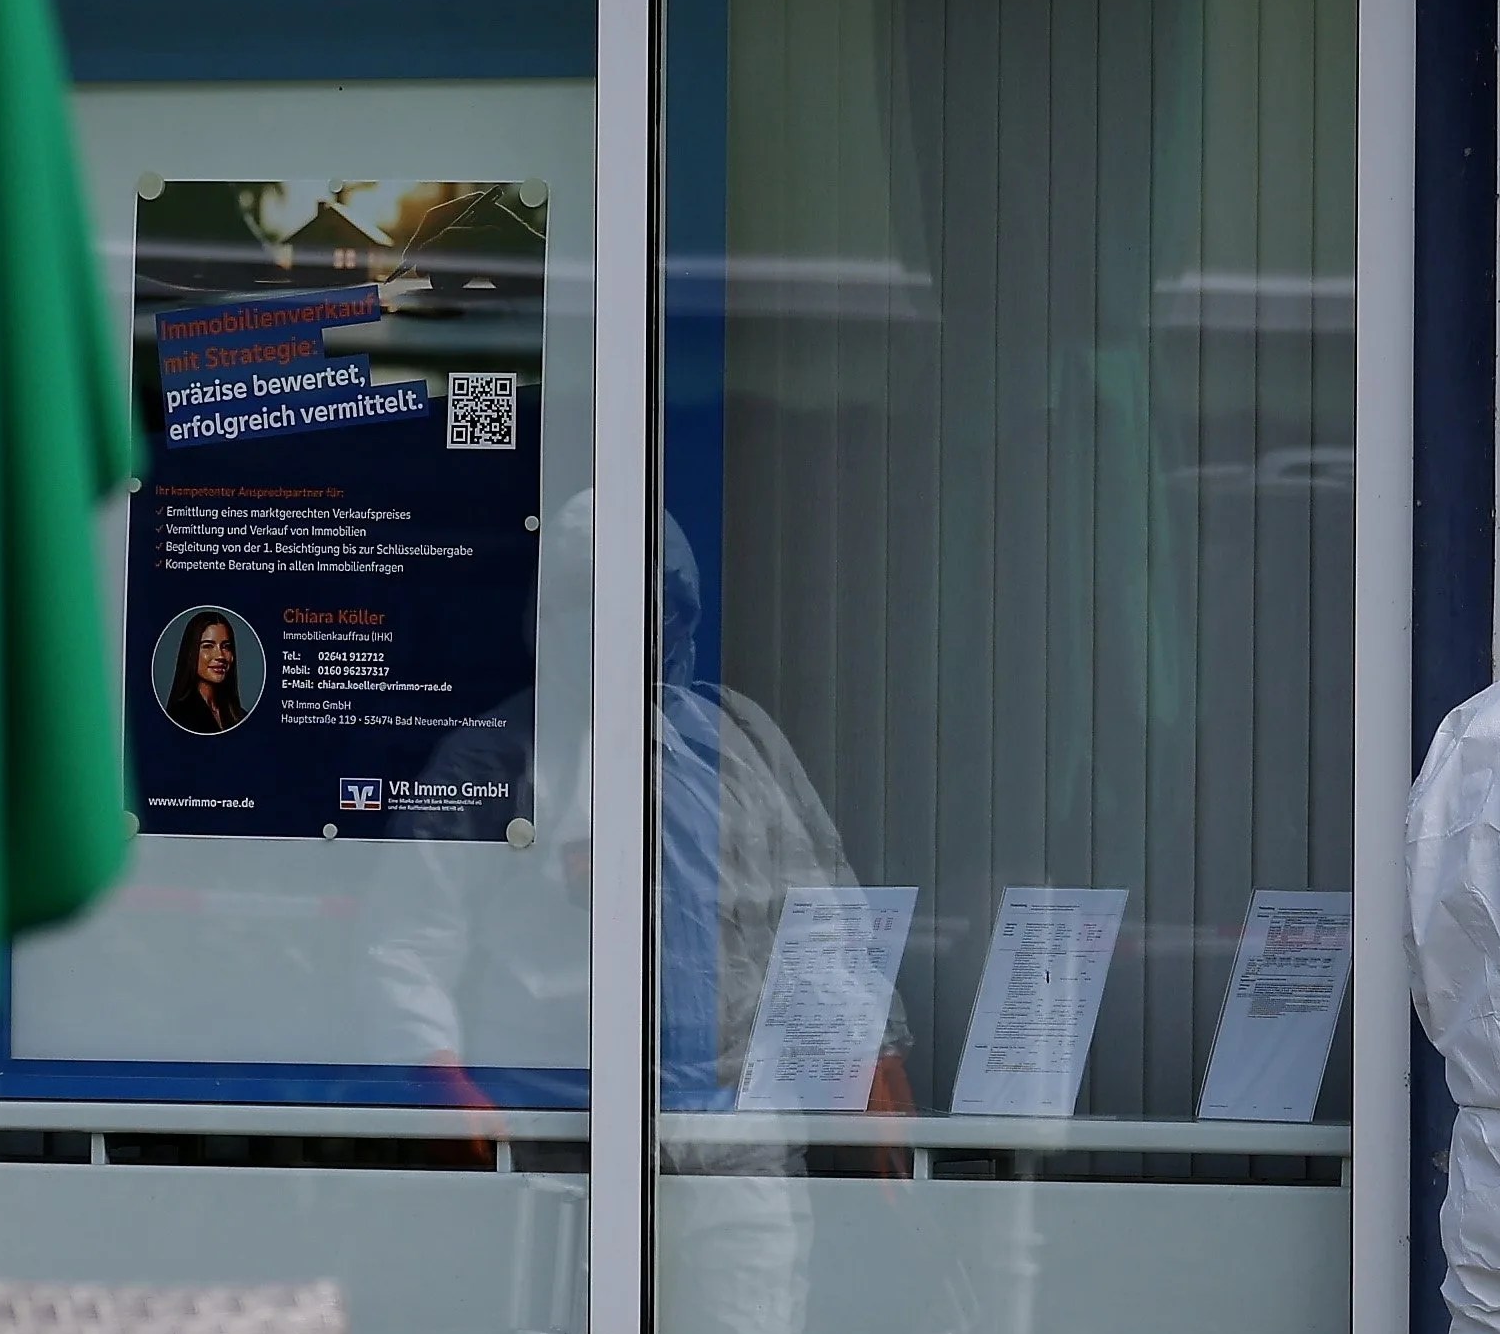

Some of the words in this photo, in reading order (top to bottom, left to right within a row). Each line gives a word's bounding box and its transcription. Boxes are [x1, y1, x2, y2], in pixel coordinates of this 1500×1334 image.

[161, 291, 376, 340] Immobilienverkauf
[165, 351, 199, 373] mit
[205, 337, 317, 368] Strategie:
[166, 379, 247, 413] präzise
[253, 364, 366, 398] bewertet,
[169, 405, 296, 440] erfolgreich
[300, 389, 424, 424] vermittelt.
[171, 486, 236, 498] kompetenter
[239, 486, 324, 499] Ansprechpartner
[166, 506, 218, 519] Ermittlung
[221, 507, 248, 518] eines
[250, 507, 330, 520] marktgerechten
[333, 508, 411, 521] Verkaufspreises
[166, 524, 225, 537] Vermittlung
[227, 525, 248, 535] und
[250, 525, 288, 536] Verkauf
[290, 528, 309, 537] von
[311, 526, 367, 537] Immobilien
[166, 541, 219, 554] Begleitung
[222, 545, 241, 553] von
[244, 543, 261, 553] der
[263, 543, 273, 553] 1.
[275, 543, 340, 557] Besichtigung
[342, 544, 357, 554] bis
[358, 547, 375, 555] zur
[376, 544, 473, 558] Schlüsselübergabe
[165, 559, 226, 572] Kompetente
[228, 560, 275, 573] Beratung
[277, 560, 287, 571] in
[289, 560, 315, 572] allen
[317, 561, 404, 575] Immobilienfragen
[283, 608, 334, 624] Chiara
[338, 608, 386, 625] Köller
[283, 630, 370, 642] Immobilienkauffrau
[371, 631, 394, 643] (IHK)
[318, 651, 348, 662] 02641
[349, 652, 385, 662] 912712
[282, 665, 311, 676] Mobil:
[317, 666, 342, 676] 0160
[281, 680, 314, 690] E-Mail:
[281, 700, 295, 710] VR
[296, 700, 321, 710] Immo
[322, 701, 352, 711] GmbH
[281, 714, 337, 726] Hauptstraße
[339, 715, 357, 725] 119
[364, 715, 394, 725] 53474
[395, 716, 413, 726] Bad
[414, 716, 507, 728] Neuenahr-Ahrweiler
[389, 781, 410, 796] VR
[414, 781, 458, 797] Immo
[461, 782, 509, 798] GmbH
[148, 795, 255, 808] www.vrimmo-rae.de
